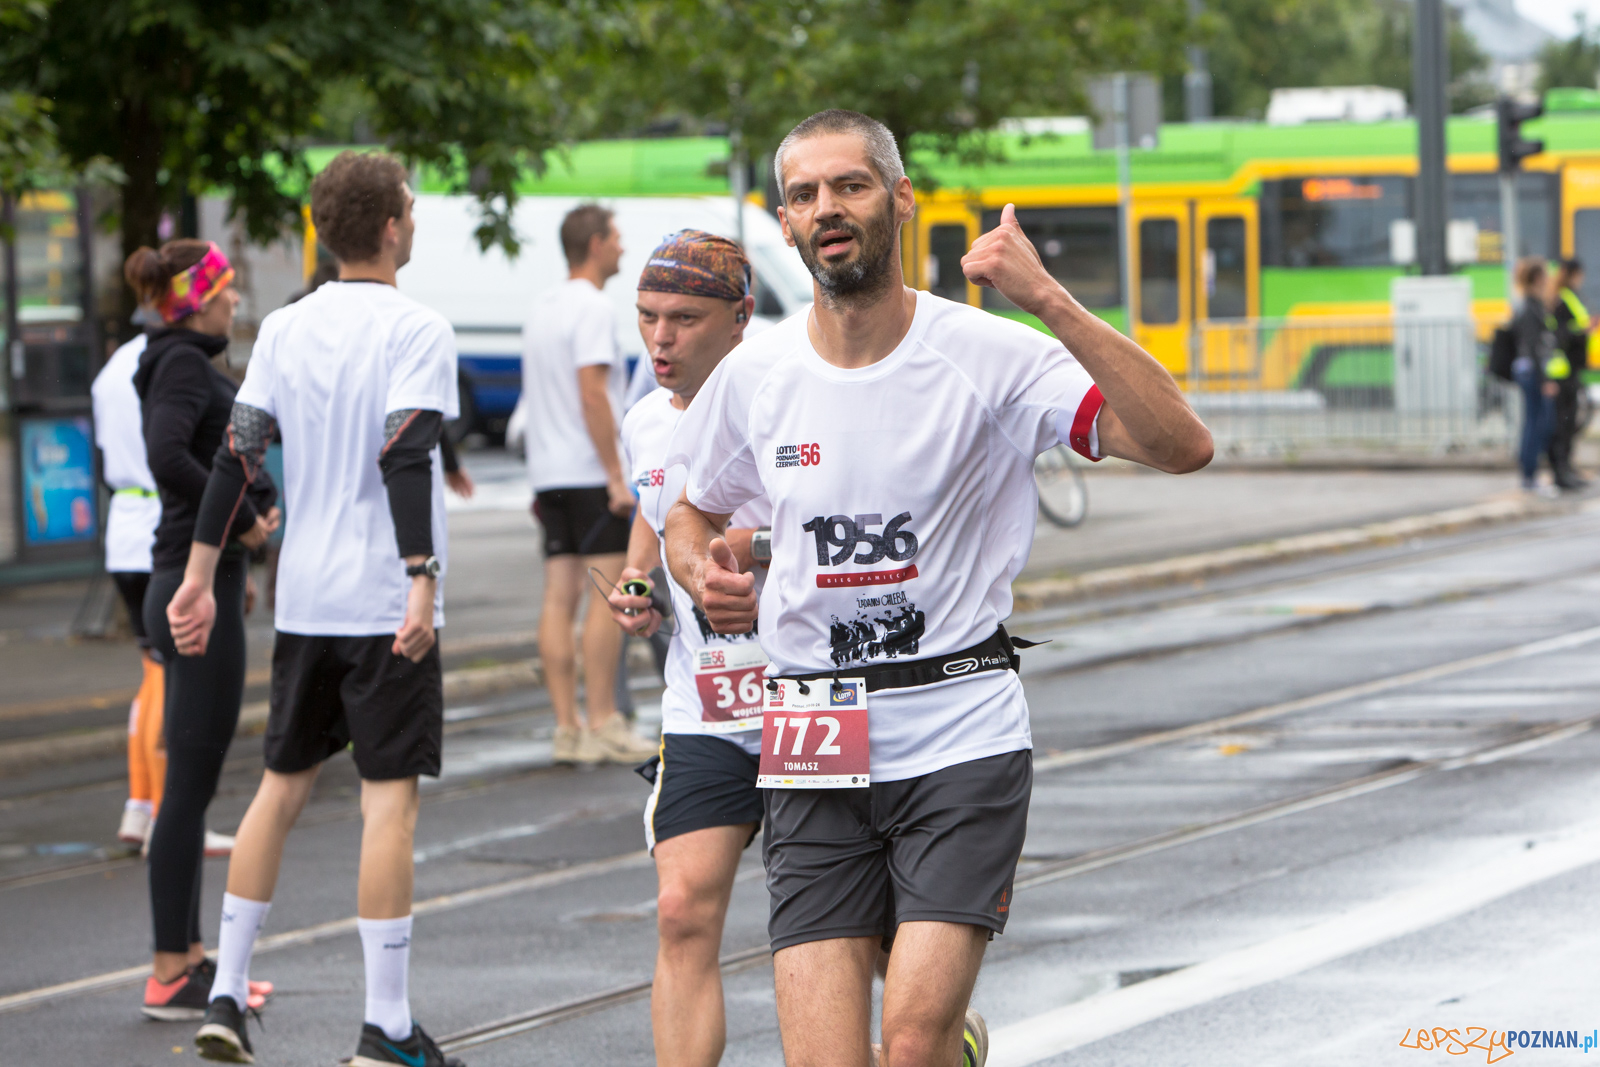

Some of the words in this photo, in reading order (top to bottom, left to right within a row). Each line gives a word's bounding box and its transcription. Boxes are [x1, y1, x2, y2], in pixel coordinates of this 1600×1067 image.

[776, 445, 797, 454] LOTTO
[776, 460, 800, 468] CZERWIEC
[802, 511, 919, 567] 1956
[881, 590, 908, 607] CHLEBA
[837, 691, 852, 700] LOTTO
[784, 762, 819, 771] TOMASZ
